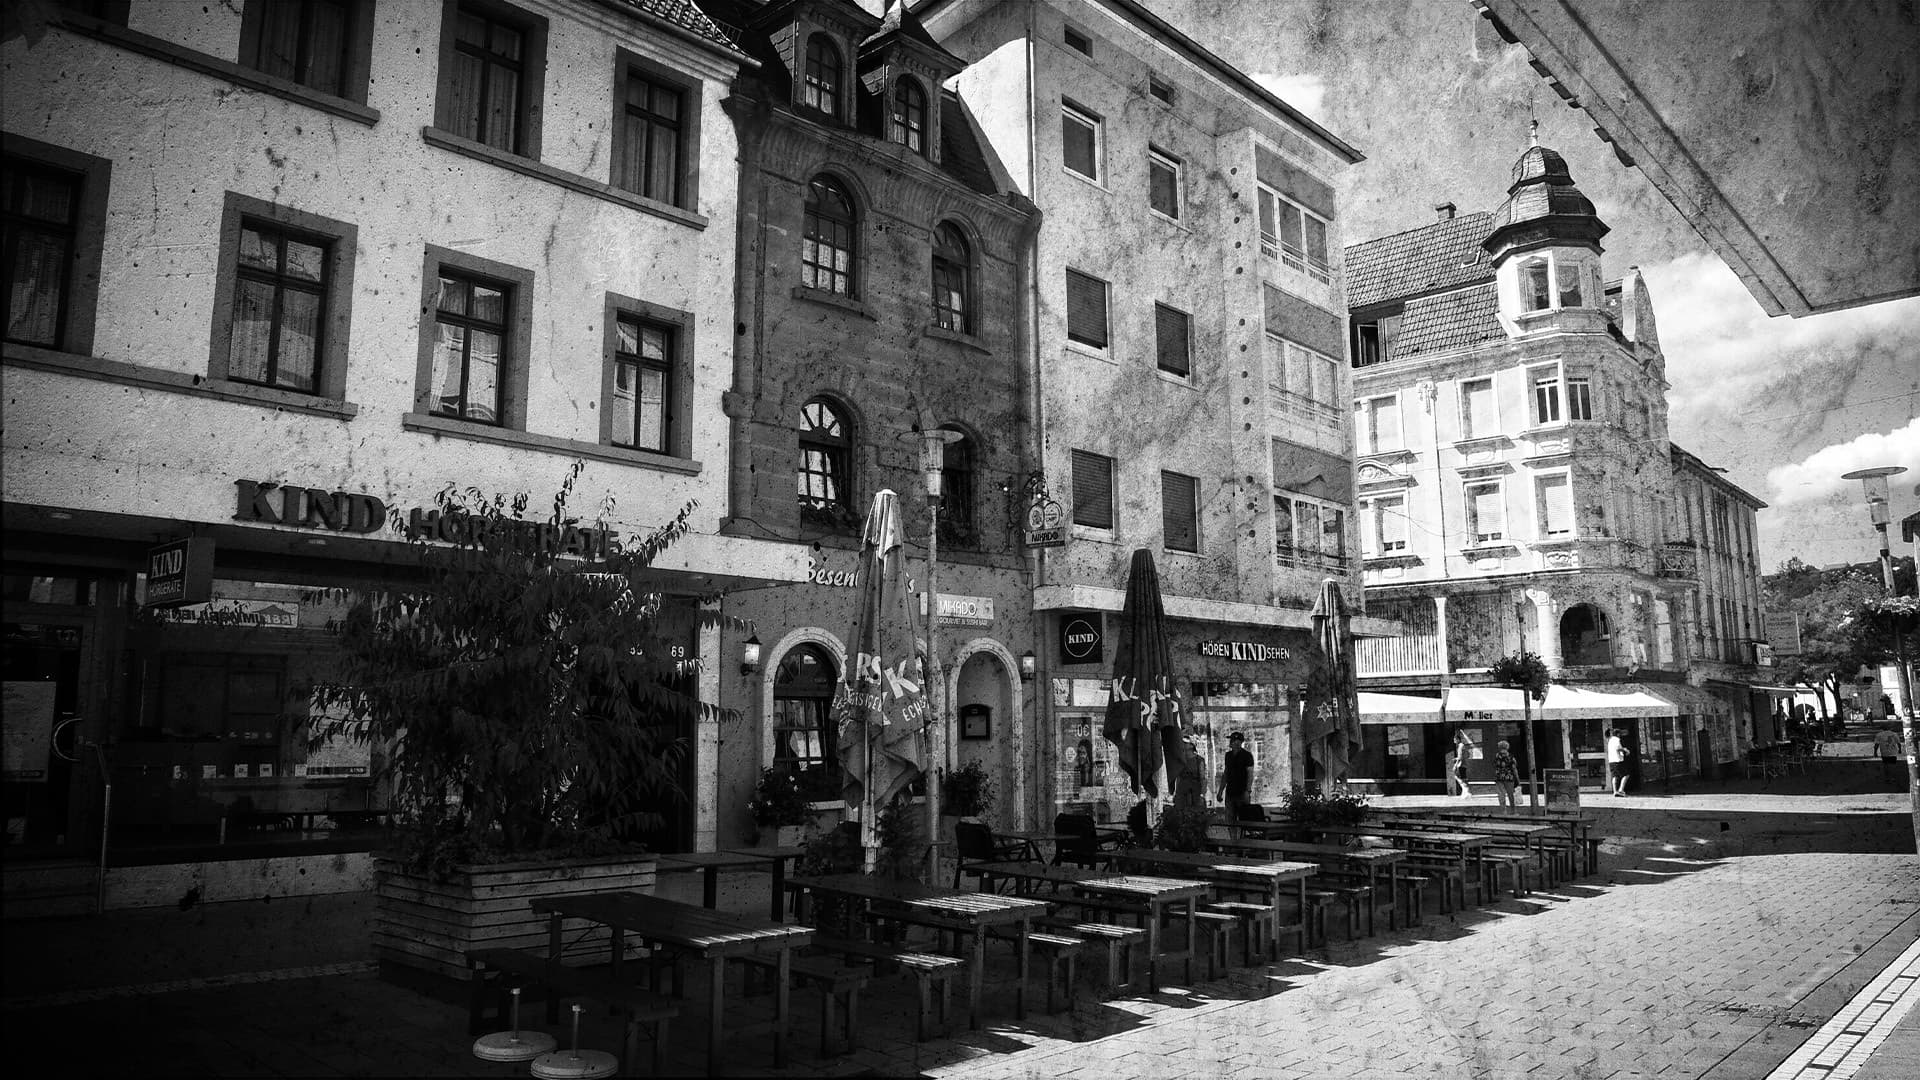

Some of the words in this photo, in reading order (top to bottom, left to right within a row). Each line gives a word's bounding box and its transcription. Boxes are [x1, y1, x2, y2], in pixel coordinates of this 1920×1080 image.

[232, 479, 386, 534] KIND
[150, 549, 183, 579] KIND
[939, 600, 977, 616] MIKADO
[1068, 633, 1094, 644] KIND
[671, 645, 685, 658] 69
[1202, 640, 1230, 657] HÖREN
[1231, 642, 1267, 661] KIND
[1266, 647, 1290, 660] SEHEN
[1464, 711, 1493, 720] Mller
